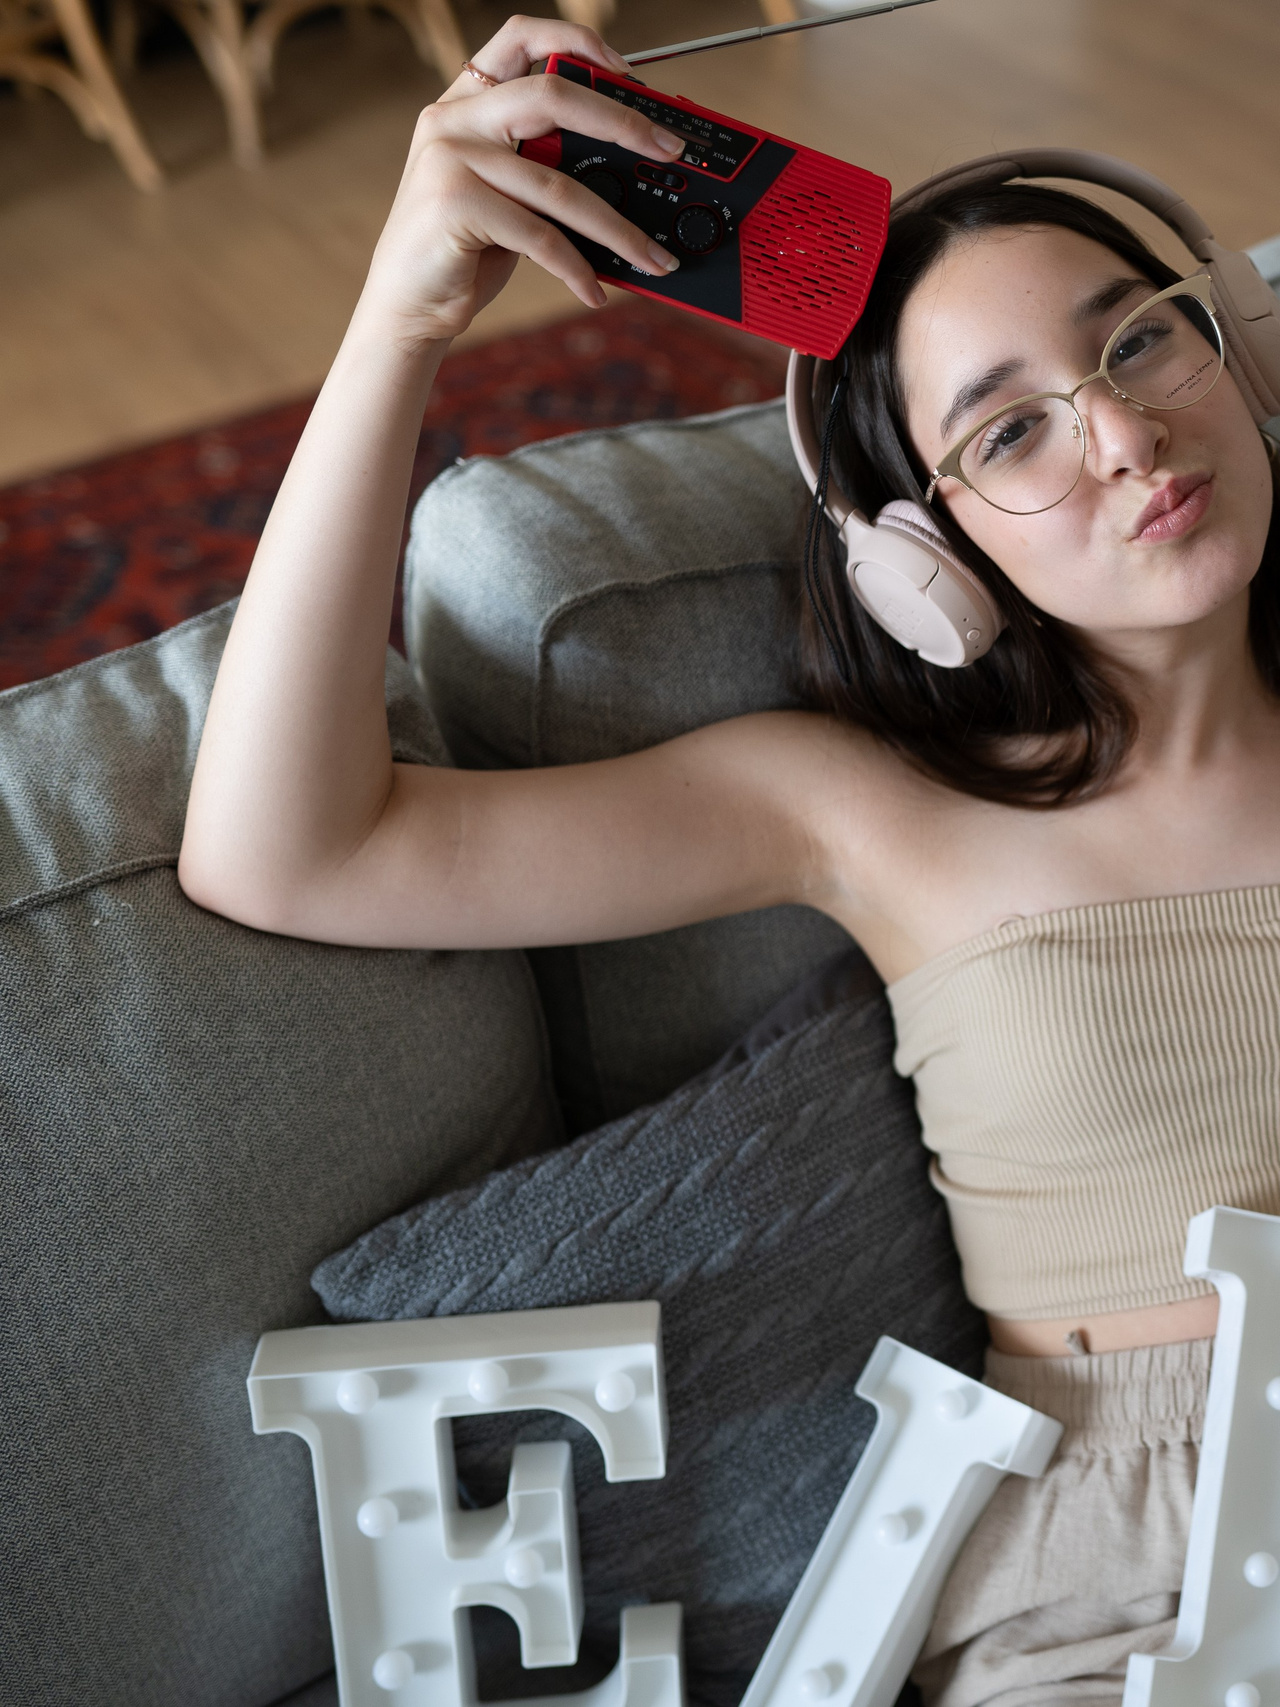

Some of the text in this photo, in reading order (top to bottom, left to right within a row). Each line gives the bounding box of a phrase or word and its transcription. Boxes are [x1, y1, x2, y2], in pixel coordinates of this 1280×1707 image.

[691, 117, 713, 130] 162.55
[682, 123, 693, 131] 104
[700, 130, 710, 138] 108
[718, 132, 732, 142] MHz
[575, 156, 603, 171] TUNING
[712, 151, 737, 165] X10 kHz
[637, 181, 647, 191] WB
[652, 188, 663, 197] AM
[668, 193, 679, 203] FM
[722, 206, 732, 221] VOL
[655, 233, 668, 242] OFF
[1166, 374, 1196, 399] CAROLINA
